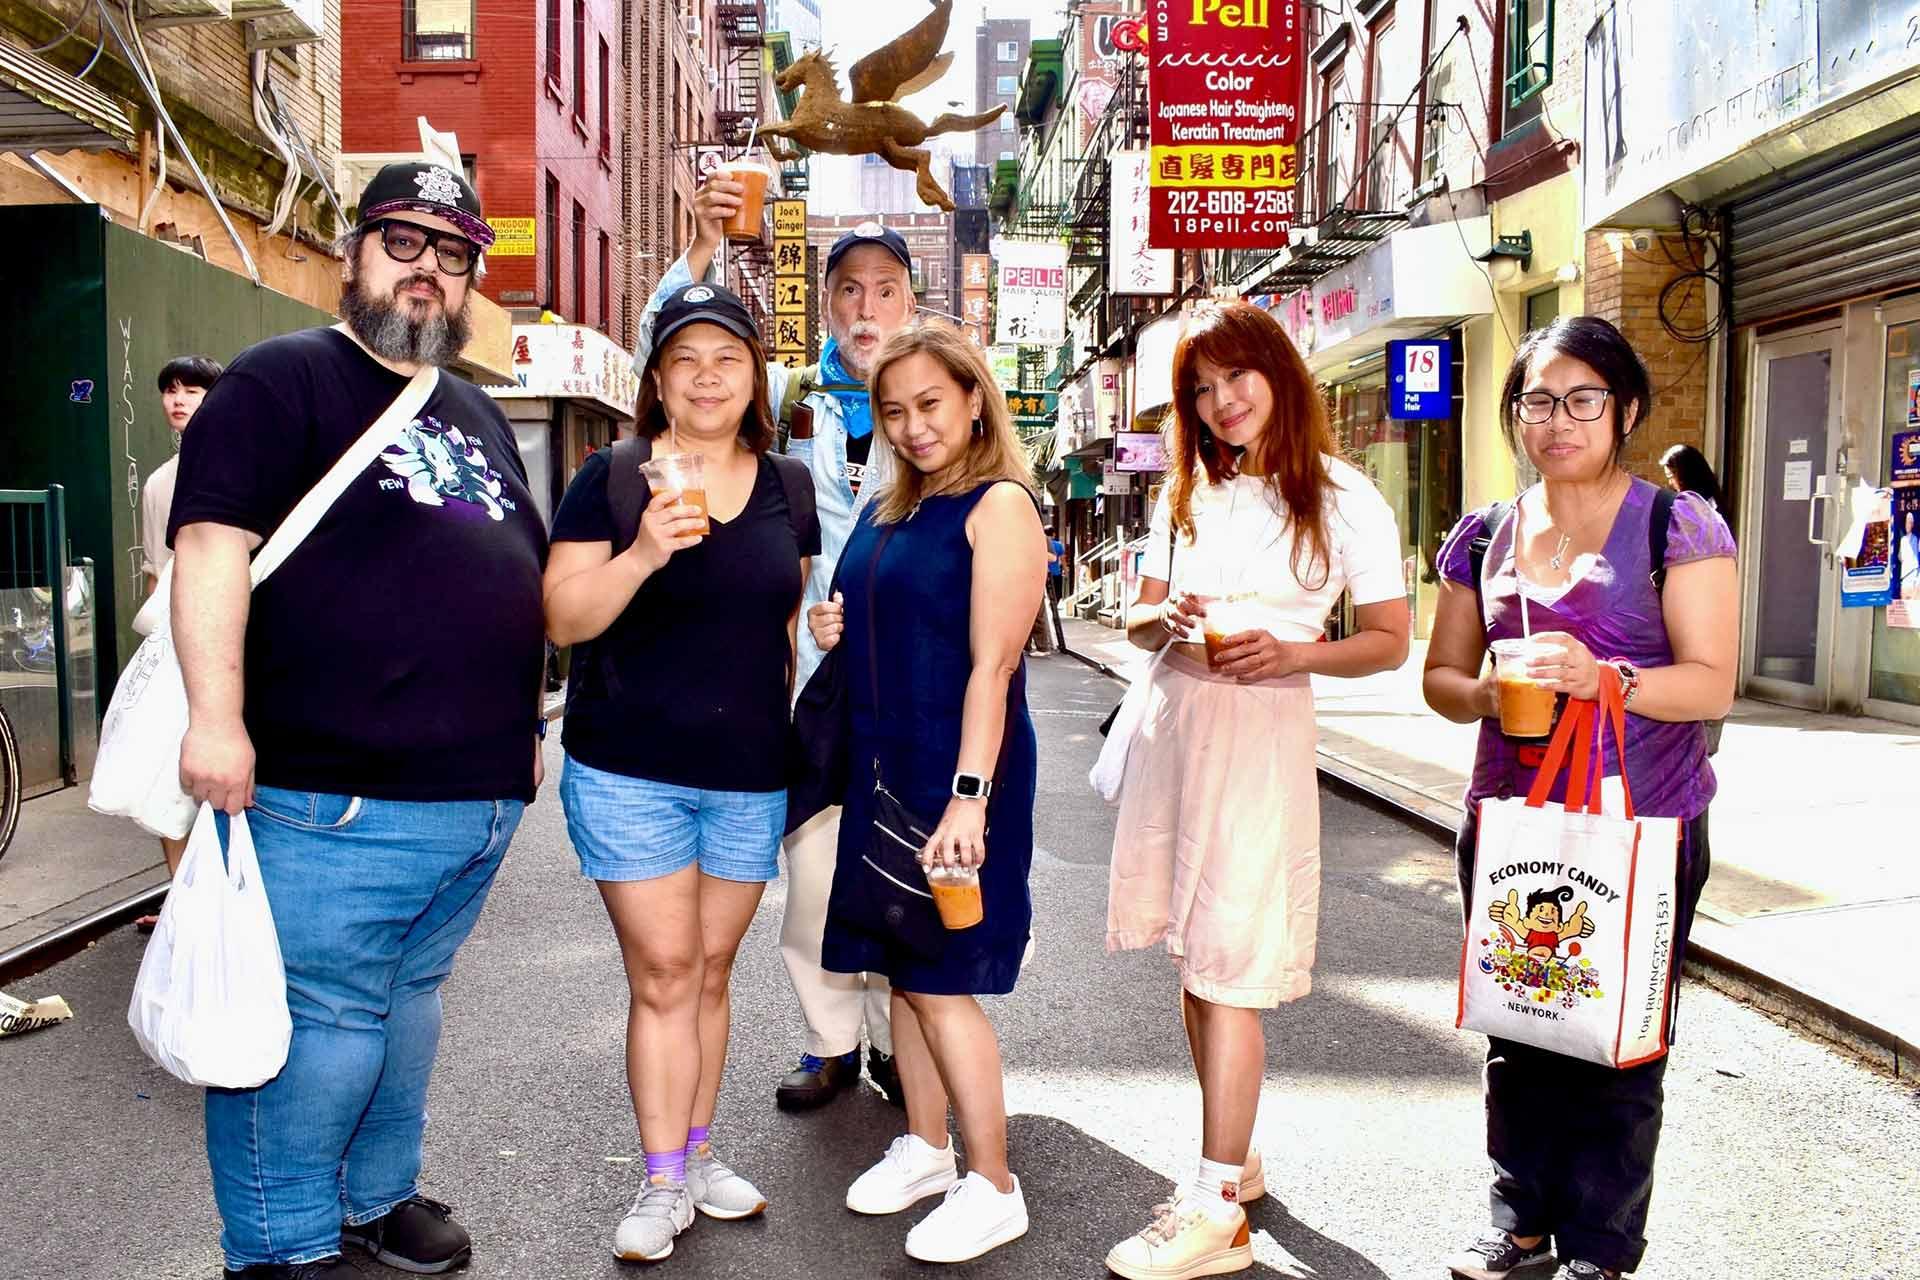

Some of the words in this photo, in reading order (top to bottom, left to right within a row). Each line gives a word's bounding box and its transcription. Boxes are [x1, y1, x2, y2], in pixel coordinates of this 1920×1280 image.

[1188, 0, 1269, 29] Pell
[1205, 70, 1254, 91] Color
[1158, 101, 1207, 122] Japanese
[1209, 99, 1233, 118] Hair
[1171, 122, 1219, 141] Keratin
[1221, 122, 1285, 142] Treatment
[779, 205, 800, 217] Joe's
[490, 219, 530, 229] KINGDOM
[775, 218, 804, 233] Ginger
[1173, 217, 1290, 233] 18Pell.com
[1003, 267, 1064, 288] PELL
[1002, 287, 1027, 296] HAIR
[1030, 287, 1064, 297] SALON
[1408, 350, 1435, 374] 18
[1404, 393, 1420, 403] Pell
[1404, 403, 1422, 412] Hair
[427, 415, 443, 429] PEW
[466, 435, 484, 447] PEW
[488, 468, 503, 480] PEW
[378, 478, 404, 491] PEW
[499, 497, 516, 512] PEW
[1489, 861, 1565, 885] ECONOMY
[1567, 867, 1621, 904] CANDY
[1508, 1001, 1530, 1014] NEW
[1531, 1005, 1560, 1021] YORK
[1637, 1014, 1652, 1041] 108
